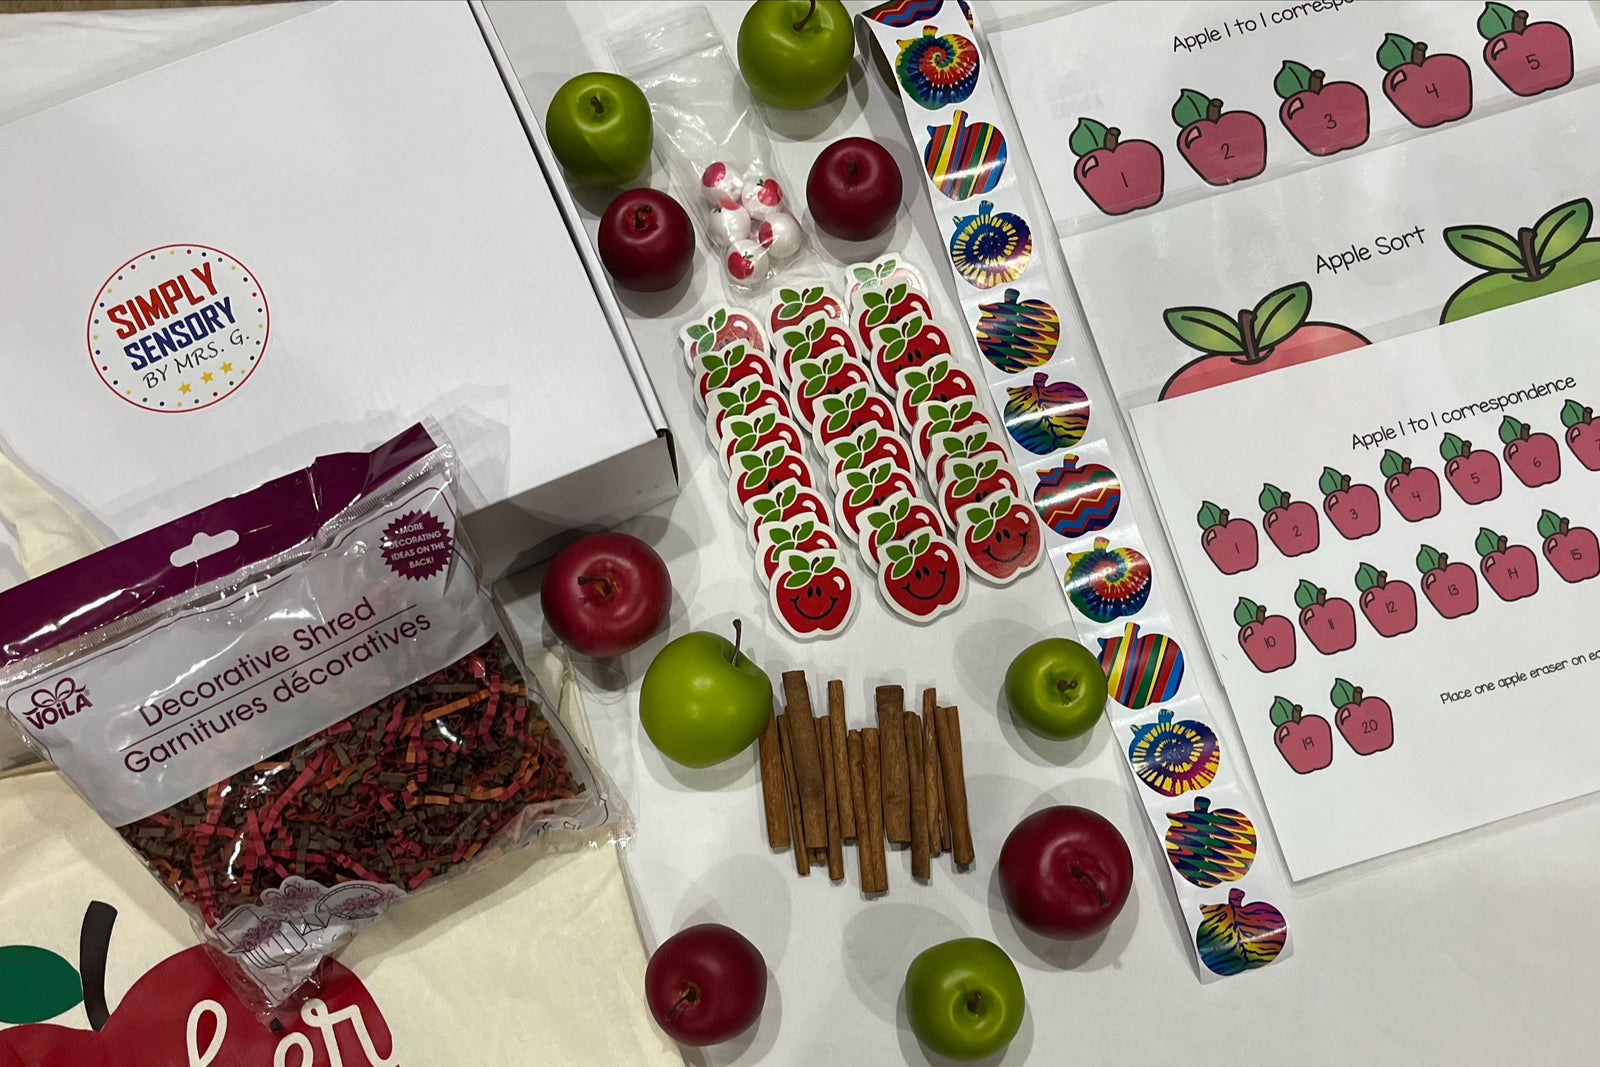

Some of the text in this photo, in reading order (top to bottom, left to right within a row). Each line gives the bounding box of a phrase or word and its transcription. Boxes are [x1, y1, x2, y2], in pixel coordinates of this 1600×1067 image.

[1173, 27, 1222, 52] Apple
[1233, 19, 1257, 34] to
[1120, 53, 1540, 188] 1 2 3 4 5
[1316, 225, 1426, 274] Apple Sort
[106, 261, 218, 340] SIMPLY
[123, 296, 236, 371] SENSORY
[142, 328, 250, 388] BY MRS. G.
[1352, 425, 1397, 450] Apple
[1407, 417, 1429, 434] to
[1441, 376, 1577, 424] correspondence
[399, 522, 425, 535] MORE
[1292, 524, 1303, 538] 2
[1348, 507, 1359, 520] 3
[1411, 490, 1422, 503] 4
[1470, 471, 1481, 485] 5
[1532, 456, 1543, 469] 6
[391, 541, 446, 561] IDEAS ON THE
[408, 556, 435, 569] BACK!
[1263, 547, 1583, 650] 10 11 12 13 14 15
[124, 614, 431, 773] Garnitures décoratives
[138, 596, 376, 727] Decorative Shred
[1440, 688, 1473, 705] Place
[1474, 681, 1496, 695] one
[1497, 672, 1528, 689] apple
[1529, 659, 1569, 679] eraser
[1570, 654, 1588, 666] on
[1301, 718, 1379, 750] 19 20
